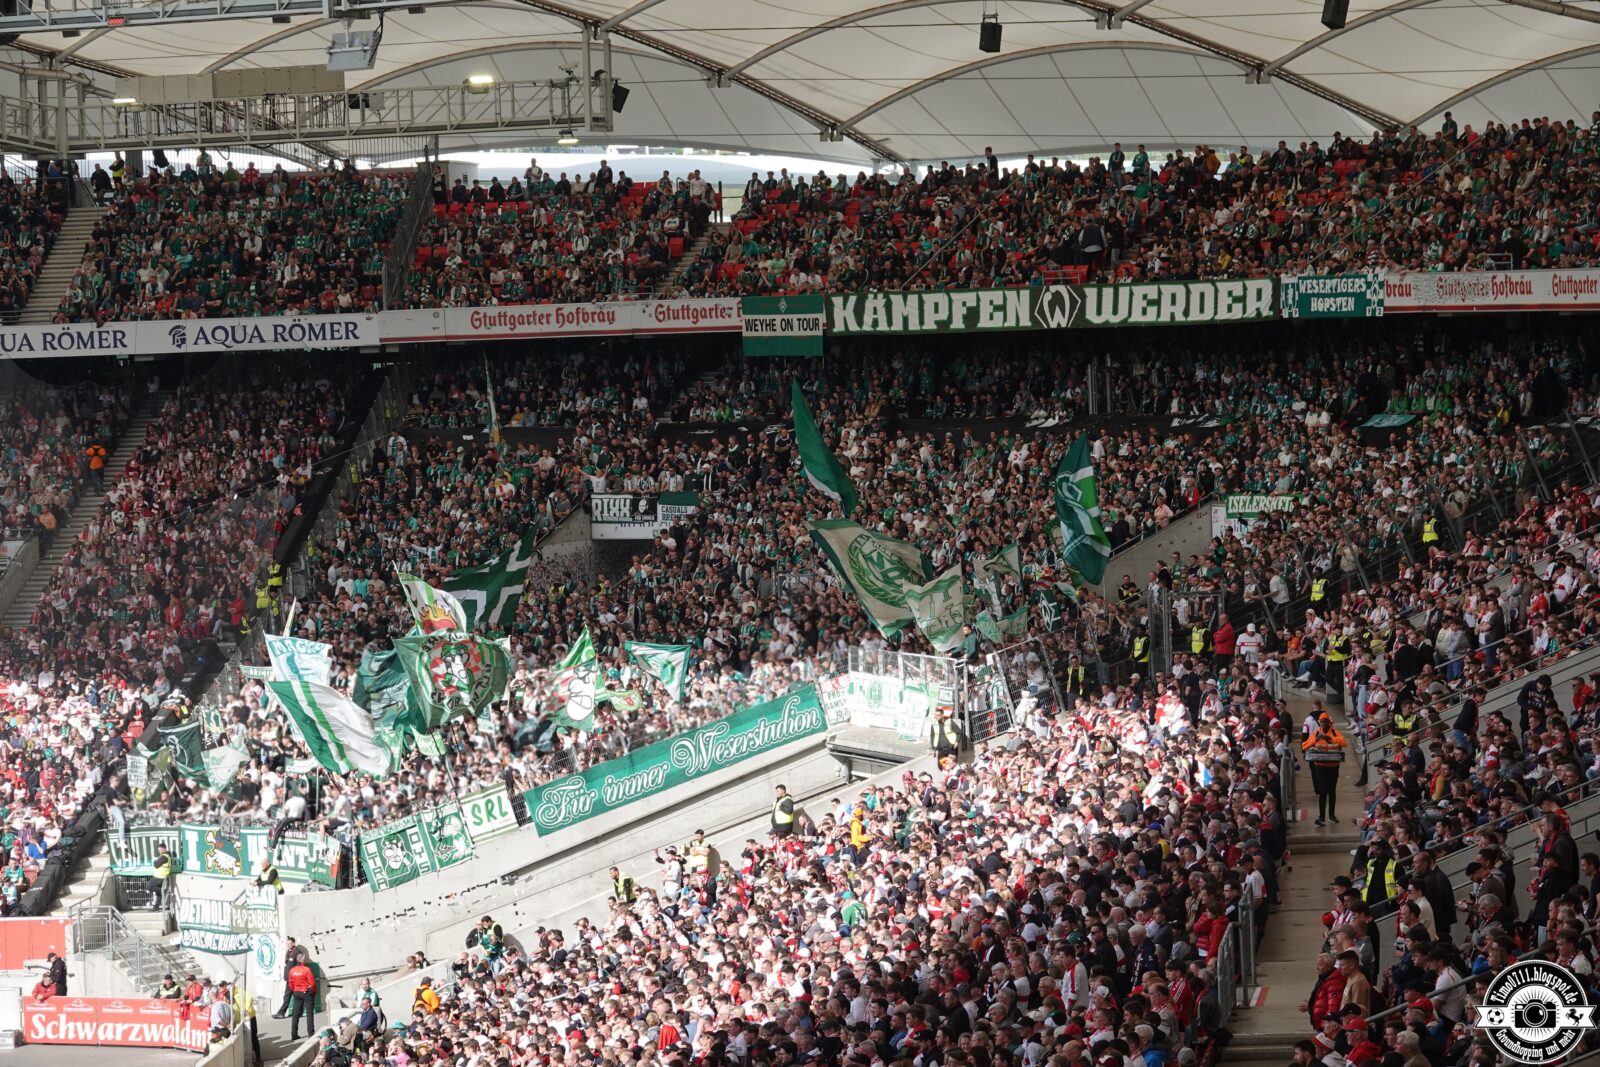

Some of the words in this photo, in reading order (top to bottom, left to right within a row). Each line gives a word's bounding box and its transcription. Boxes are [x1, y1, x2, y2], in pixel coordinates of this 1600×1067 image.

[1299, 278, 1367, 294] WESERTIGERS
[1384, 276, 1412, 298] bräu
[1552, 273, 1598, 301] Stuttgarter
[831, 289, 1035, 332] KÄMPFEN
[1084, 279, 1275, 324] WERDER
[1311, 297, 1355, 312] HOPSTEN
[470, 309, 551, 331] Stuttgarter
[555, 306, 617, 329] Hofbräu
[744, 318, 777, 332] WEYHE
[780, 318, 793, 332] ON
[797, 317, 820, 331] TOUR
[41, 327, 128, 351] RÖMER
[193, 323, 266, 348] AQUA
[273, 318, 361, 343] RÖMER
[592, 498, 630, 521] RIXX
[662, 513, 686, 521] BREE
[536, 775, 597, 827] Für
[603, 761, 669, 806] immer
[670, 695, 821, 776] Weserstadion
[471, 795, 508, 827] SRL
